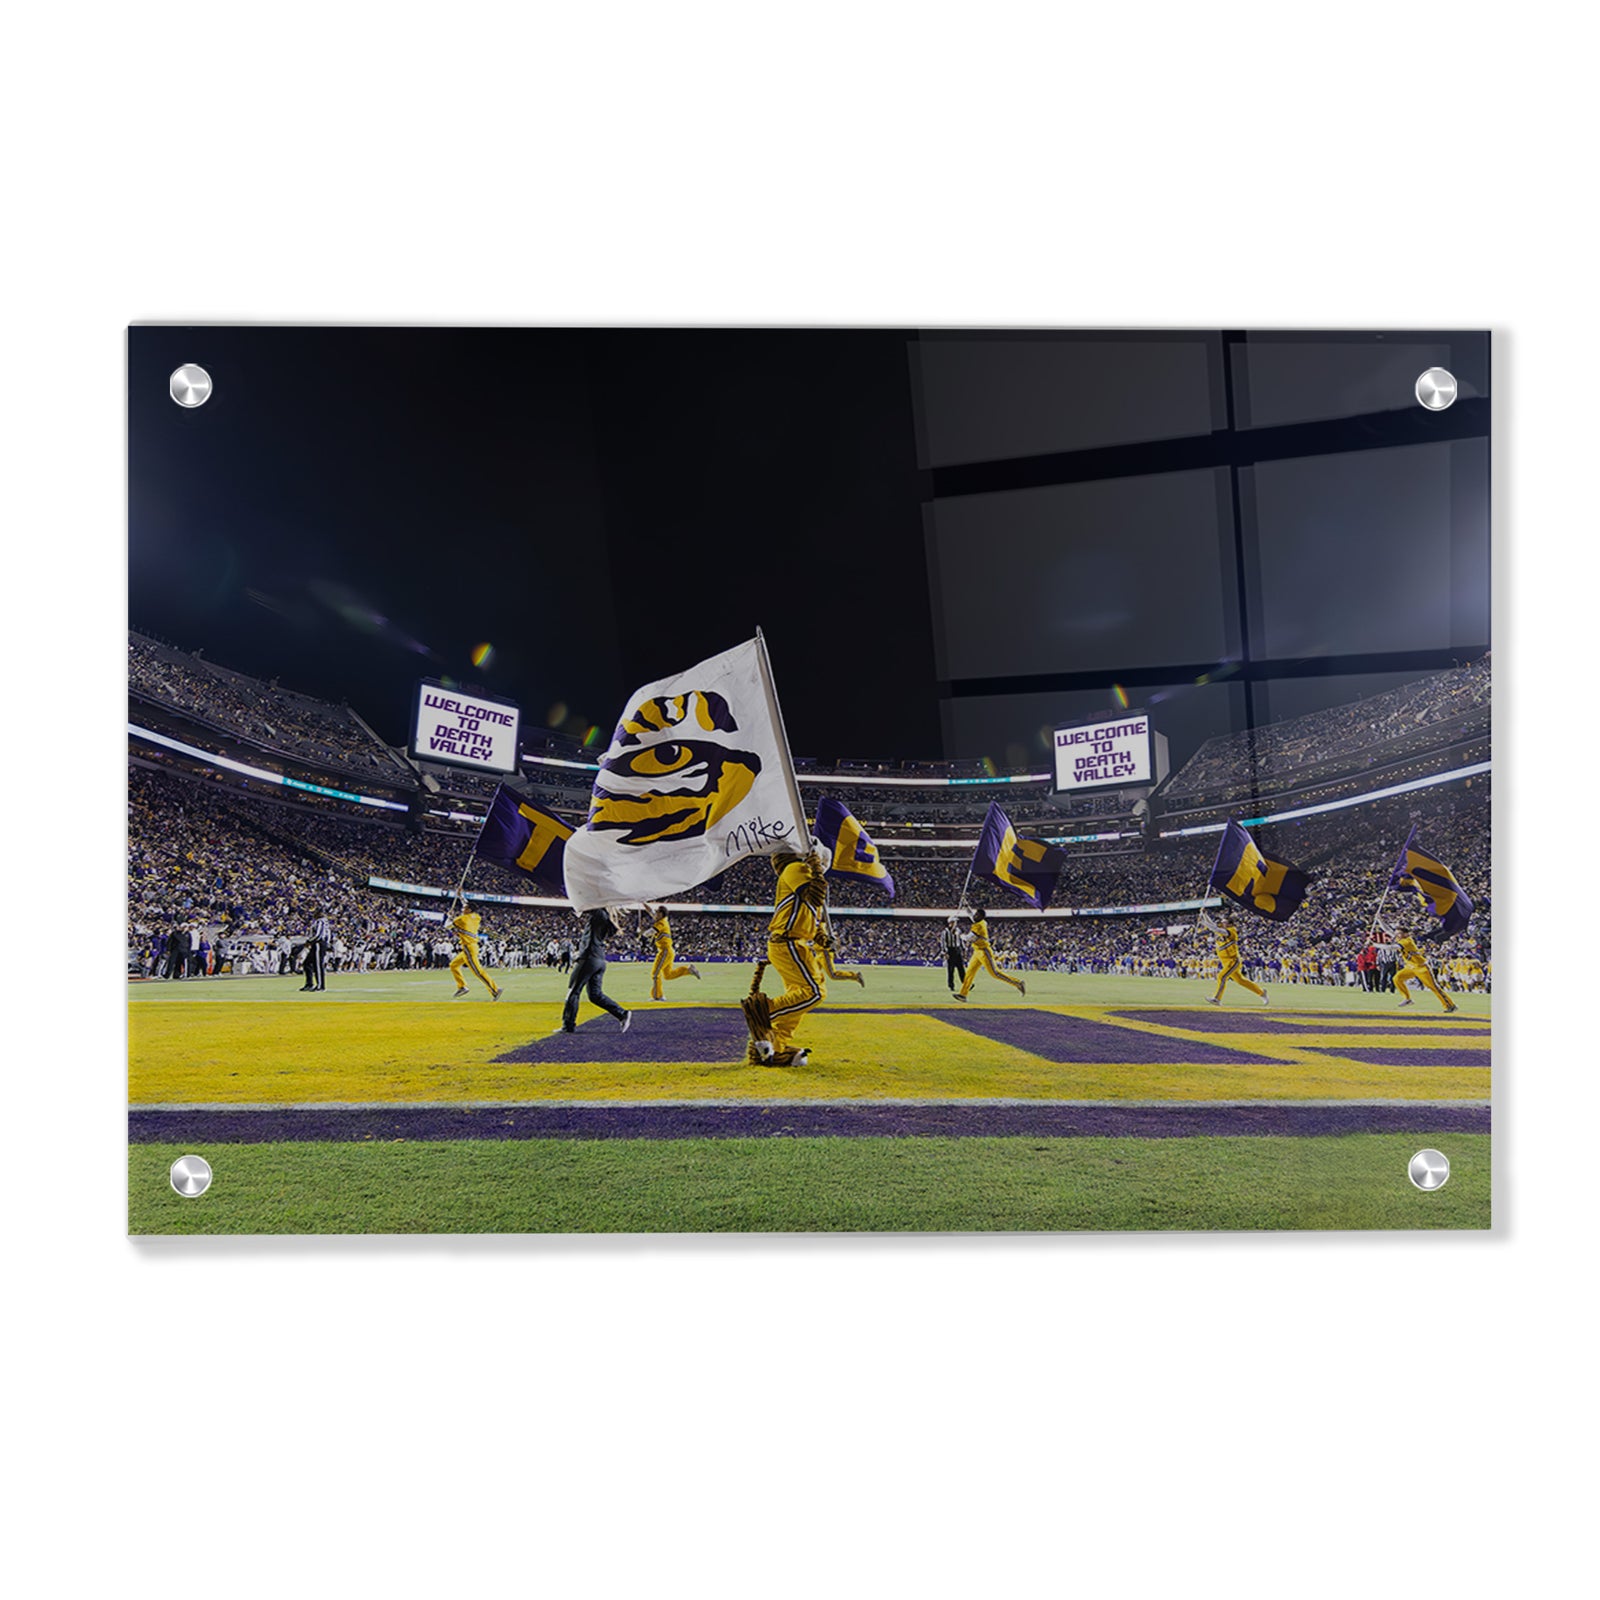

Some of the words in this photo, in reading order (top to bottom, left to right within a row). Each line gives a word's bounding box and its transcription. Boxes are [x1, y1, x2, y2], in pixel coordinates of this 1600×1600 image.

[424, 694, 514, 727] WELCOME
[458, 716, 480, 731] TO
[1057, 722, 1146, 747] WELCOME
[430, 736, 493, 761] VALLEY
[435, 725, 493, 748] DEATH
[1090, 740, 1113, 754] TO
[1075, 750, 1131, 769] DEATH
[1073, 763, 1136, 782] VALLEY
[516, 802, 573, 873] T
[725, 816, 795, 857] Mike
